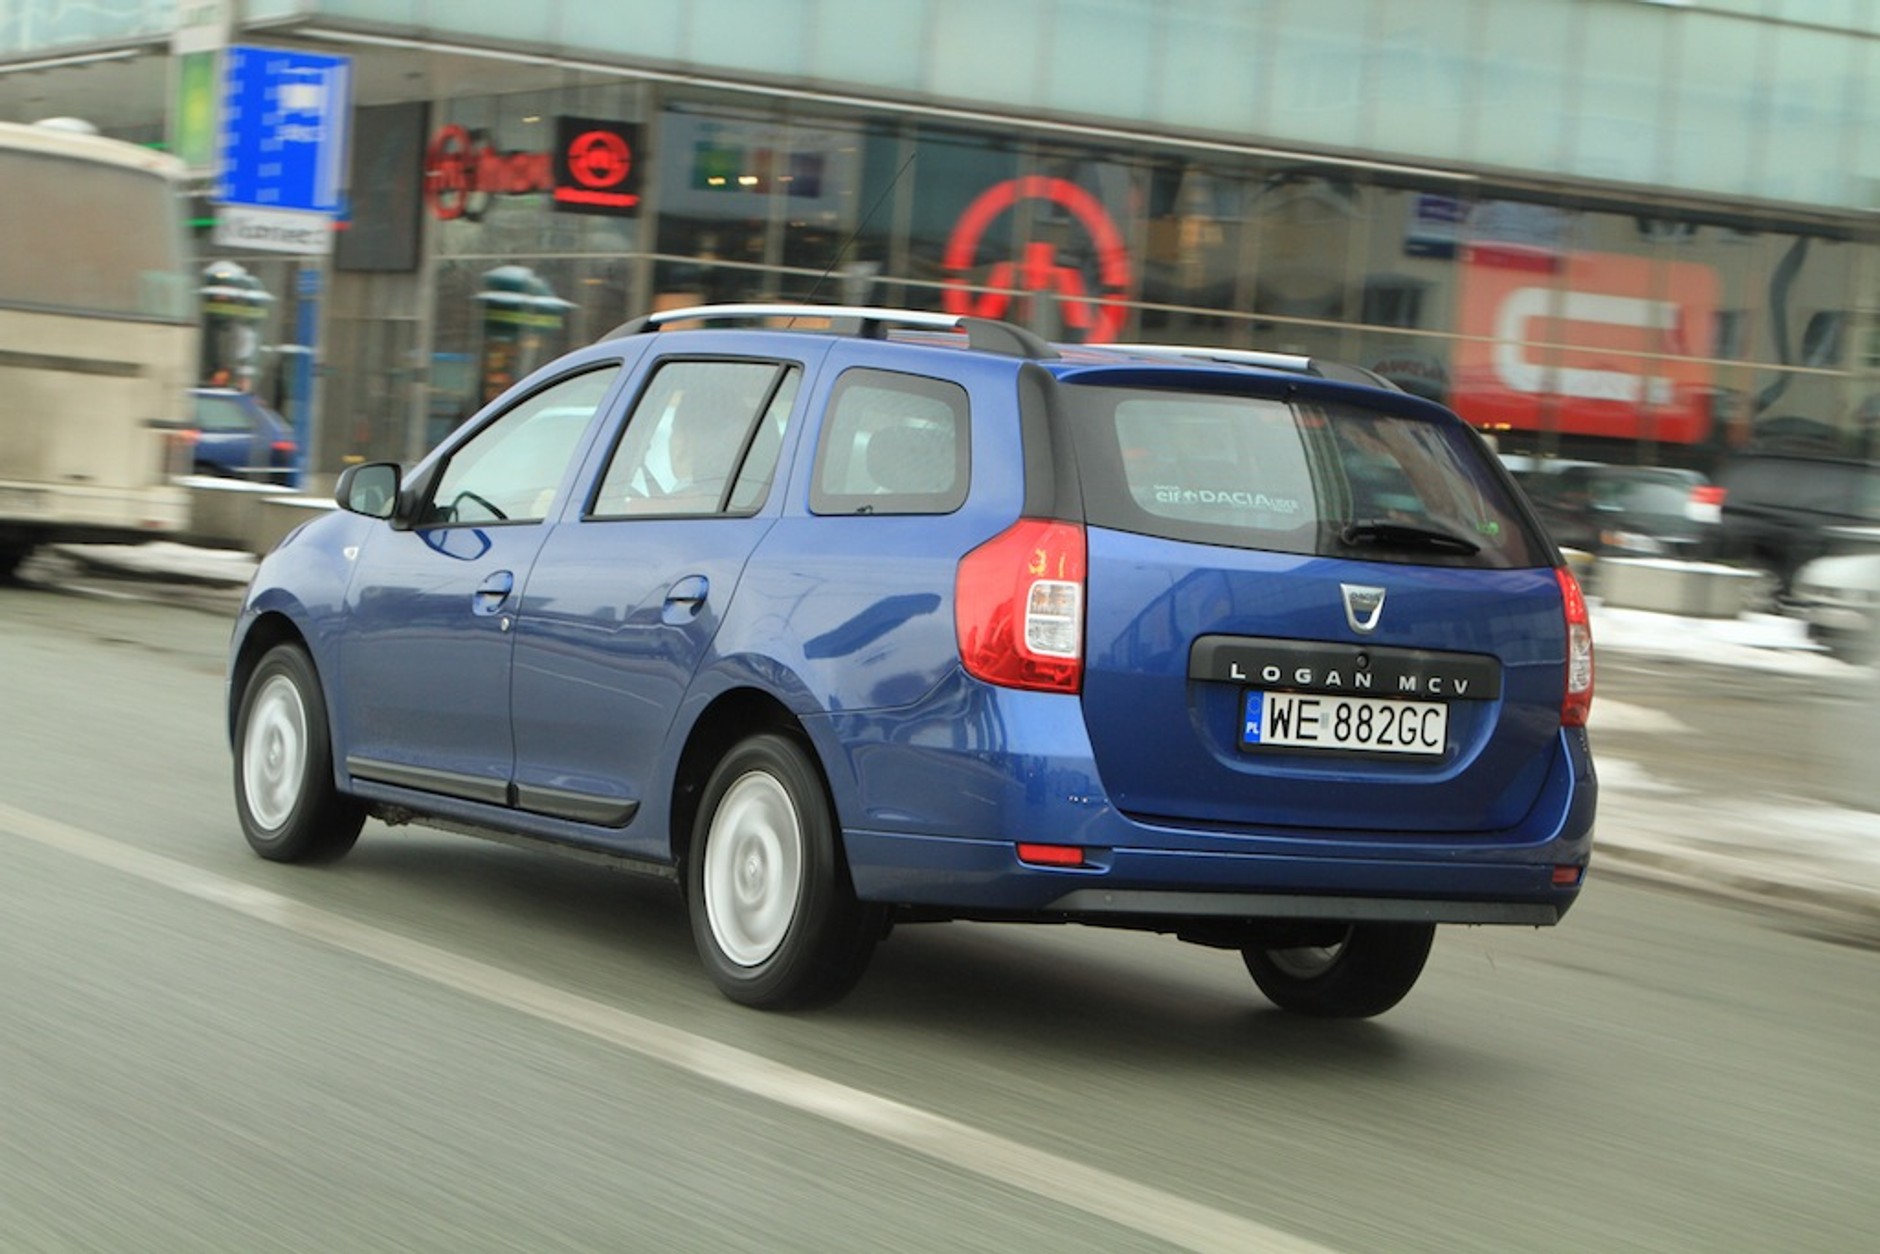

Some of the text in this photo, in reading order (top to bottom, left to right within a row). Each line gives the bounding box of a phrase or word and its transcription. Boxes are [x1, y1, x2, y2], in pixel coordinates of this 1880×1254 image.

[1199, 489, 1271, 508] DACIA
[1230, 663, 1469, 694] LOGAN MCV
[1245, 721, 1260, 734] PL
[1269, 697, 1441, 747] WE 882GC
